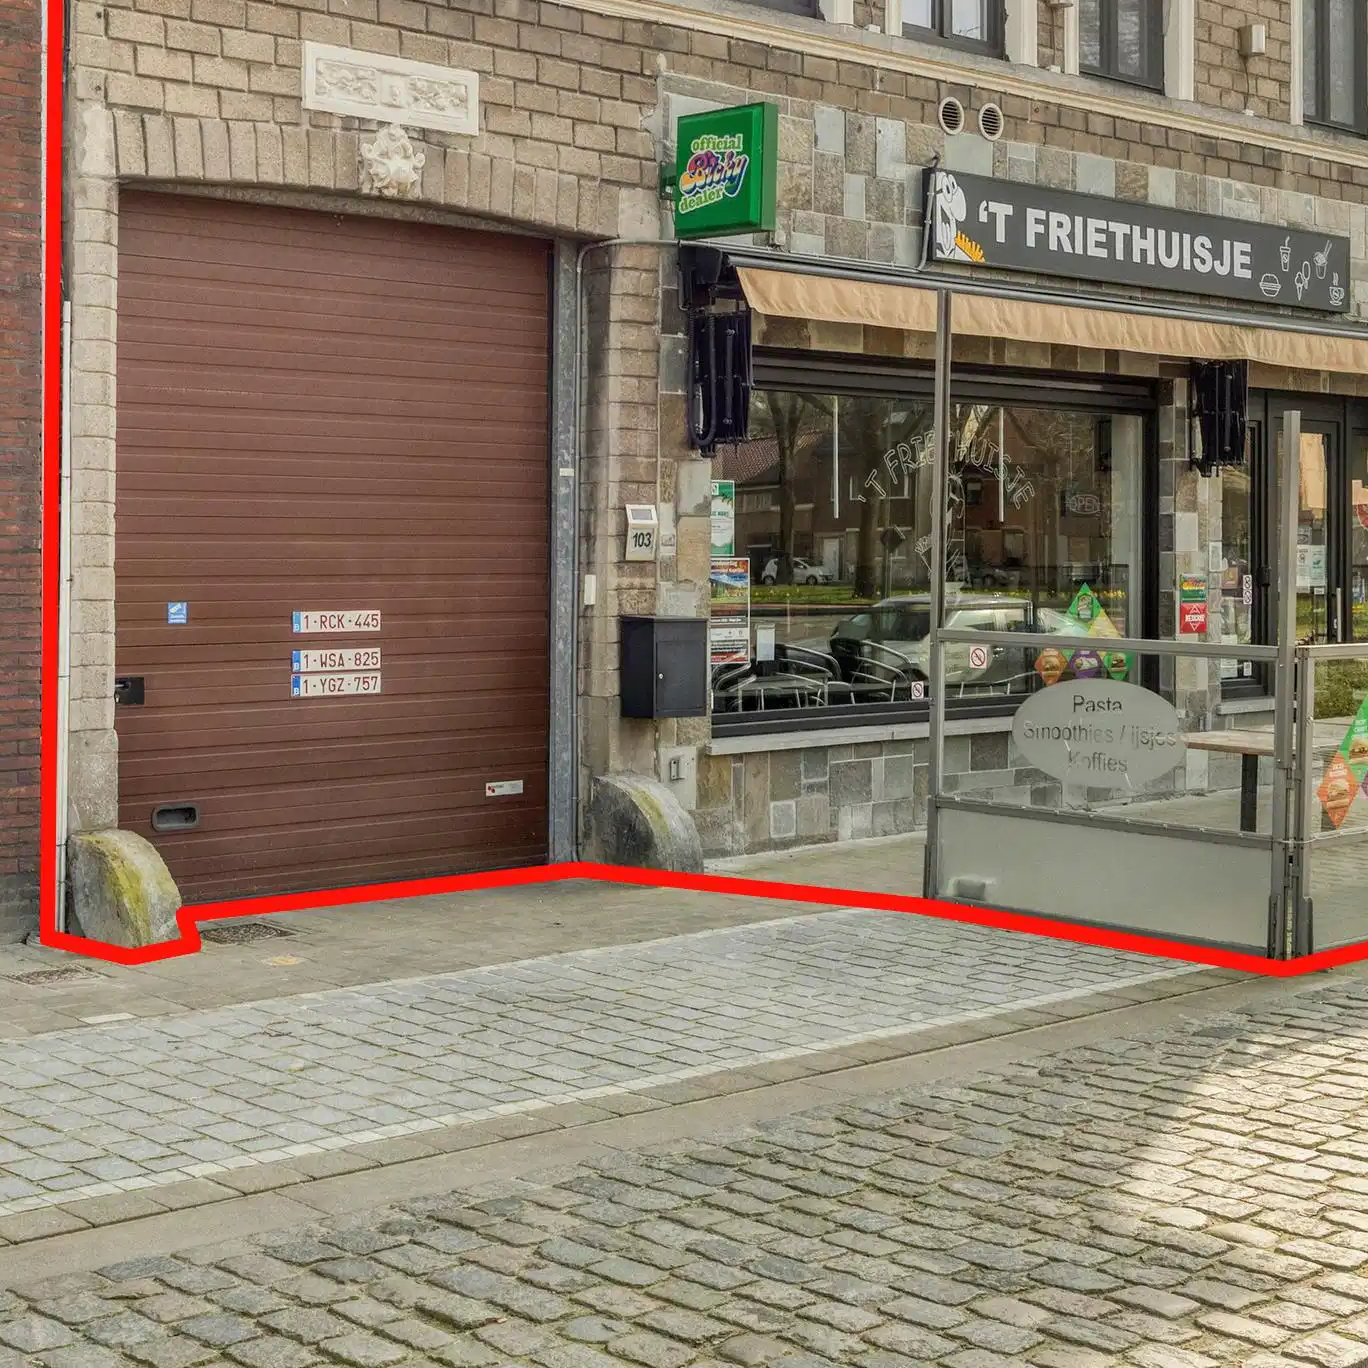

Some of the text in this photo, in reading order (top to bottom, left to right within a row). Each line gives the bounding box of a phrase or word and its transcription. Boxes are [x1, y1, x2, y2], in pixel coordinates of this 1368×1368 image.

[692, 134, 743, 152] official
[680, 151, 749, 197] Bicky
[679, 187, 723, 213] dealer
[1026, 208, 1252, 279] FRIETHUISJE
[883, 431, 1035, 510] FRIEHUISJE
[632, 532, 651, 547] 103
[1072, 694, 1123, 714] Pasta
[1023, 720, 1114, 744] Smoothies
